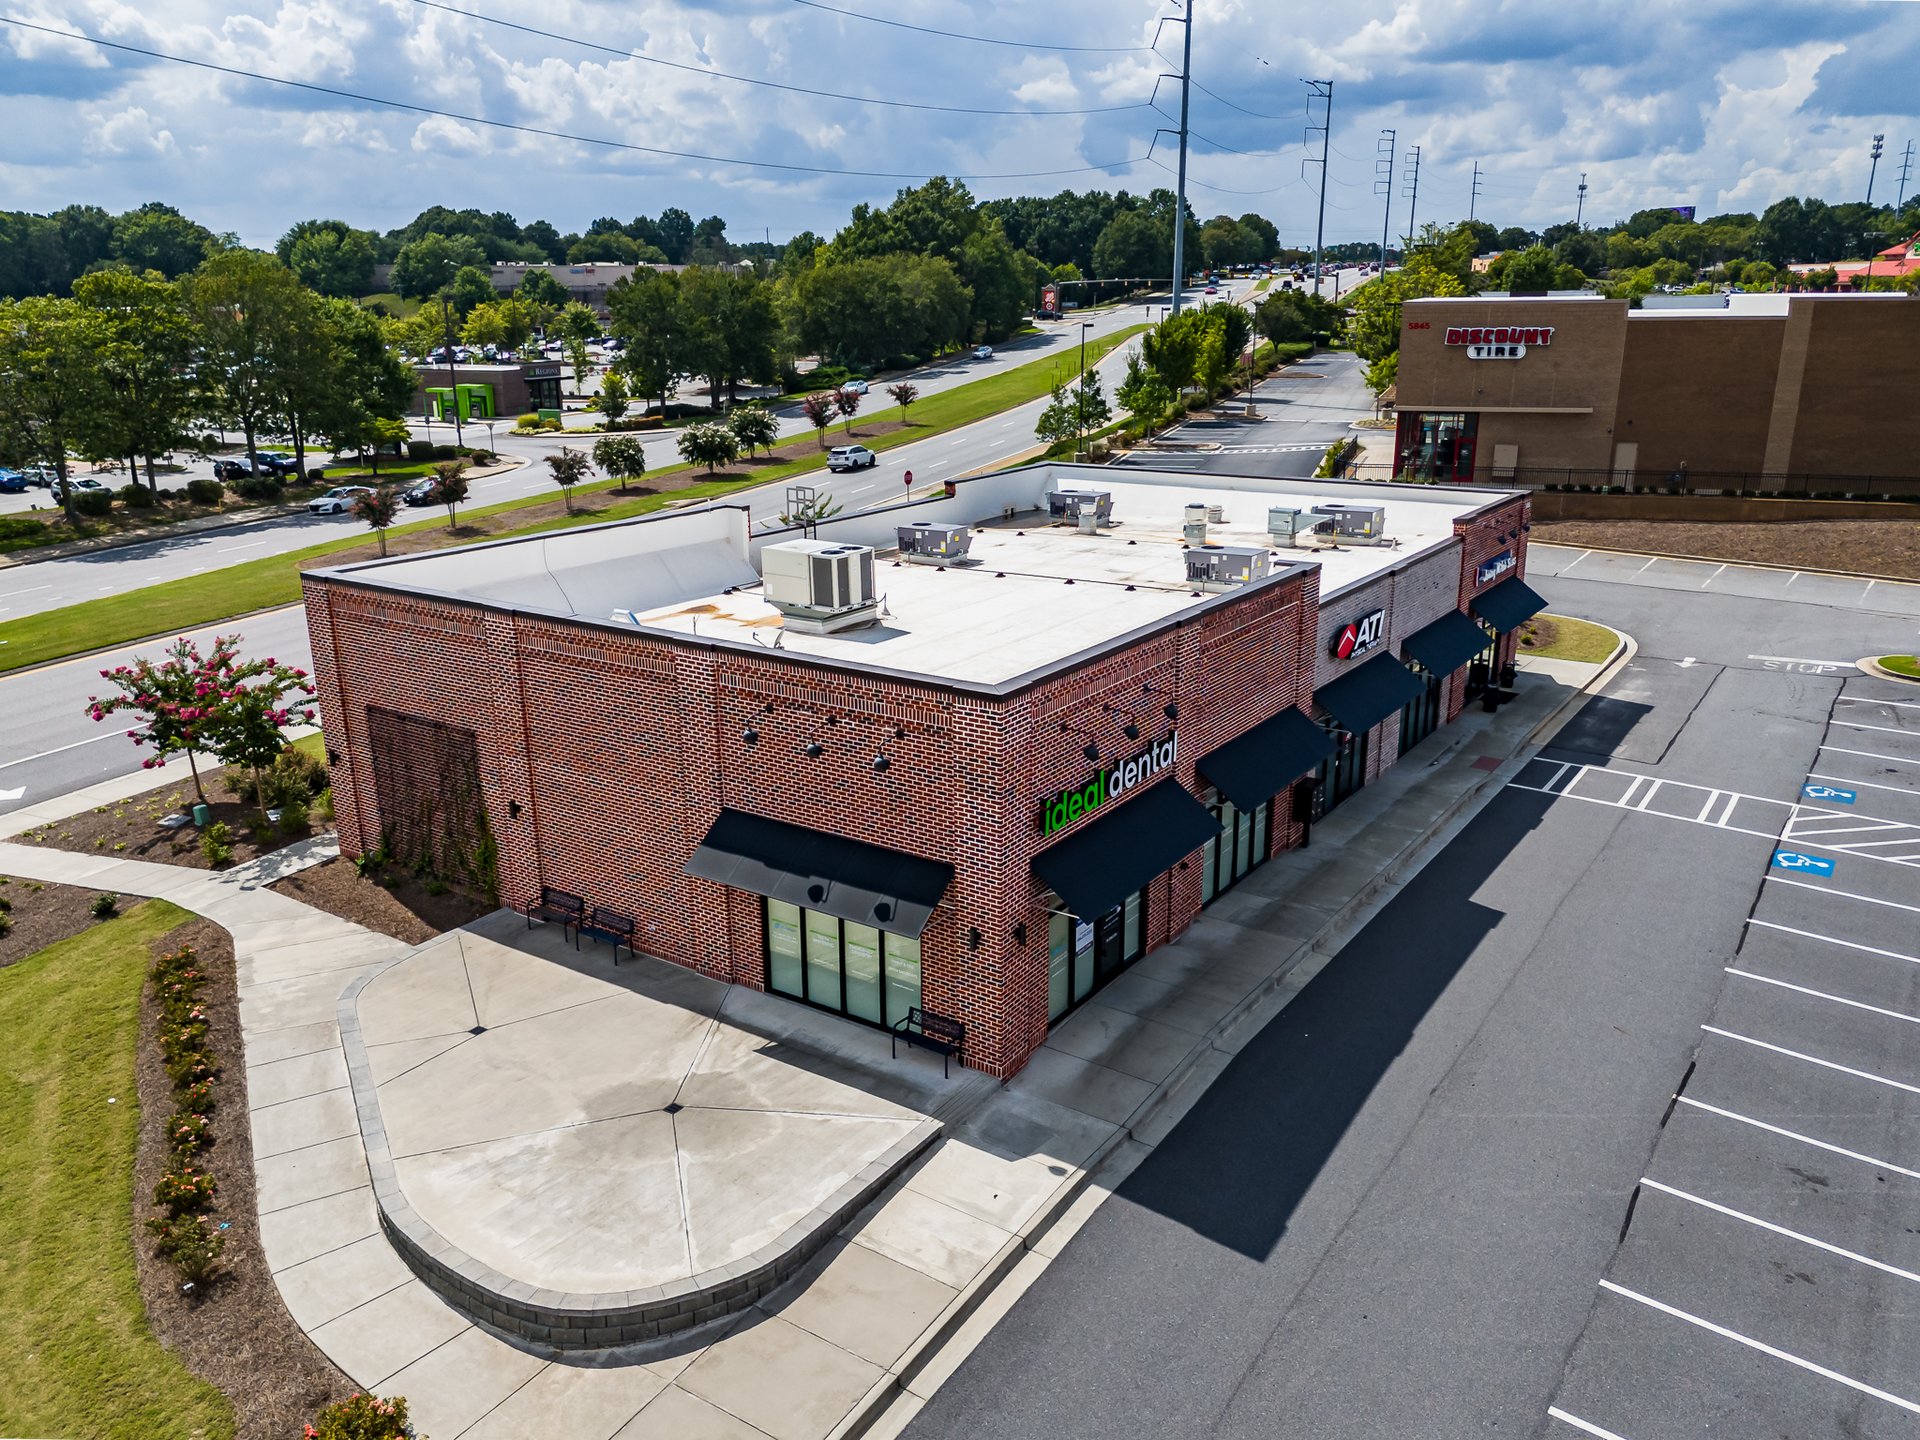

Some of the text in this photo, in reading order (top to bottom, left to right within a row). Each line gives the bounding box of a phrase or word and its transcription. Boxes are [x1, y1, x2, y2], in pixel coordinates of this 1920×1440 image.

[1408, 322, 1431, 330] 5845
[1446, 328, 1551, 344] DISCOUNT
[1474, 346, 1519, 357] TIRE
[1354, 610, 1385, 650] ATI
[1762, 660, 1837, 674] STOP
[1044, 730, 1178, 837] ideal dental
